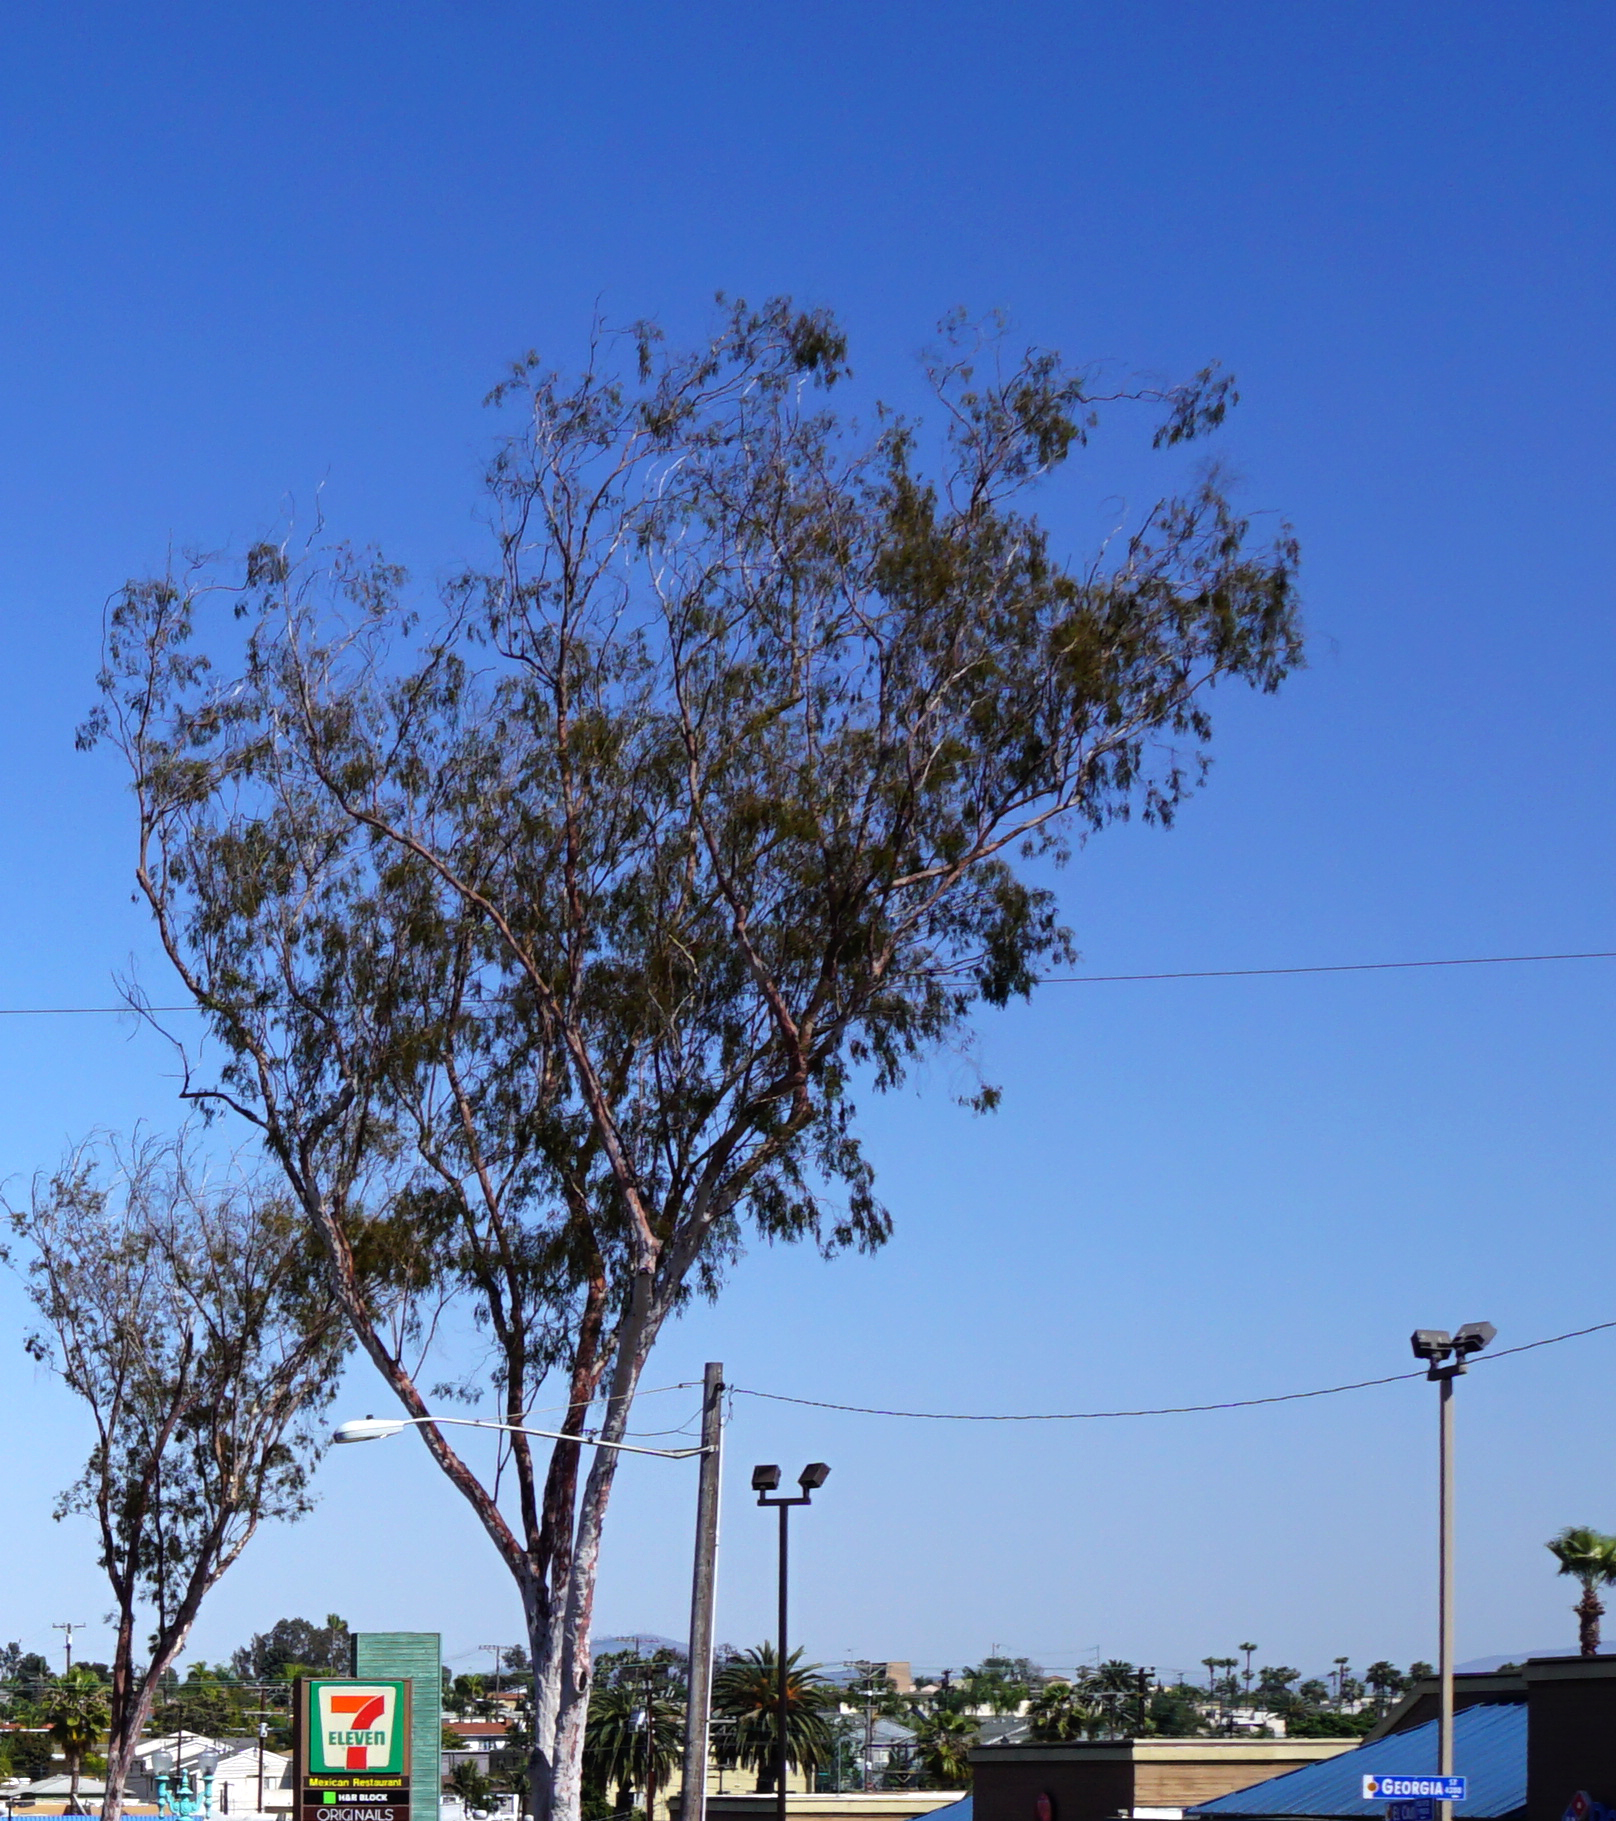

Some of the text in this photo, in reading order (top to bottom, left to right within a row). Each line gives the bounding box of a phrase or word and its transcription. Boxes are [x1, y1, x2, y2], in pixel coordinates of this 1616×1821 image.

[331, 1695, 385, 1769] 7
[309, 1778, 402, 1787] Mexican Restaurant
[1382, 1778, 1443, 1795] GEORGIA
[359, 1794, 388, 1802] BLOCK
[317, 1808, 394, 1821] ORIGINAILS
